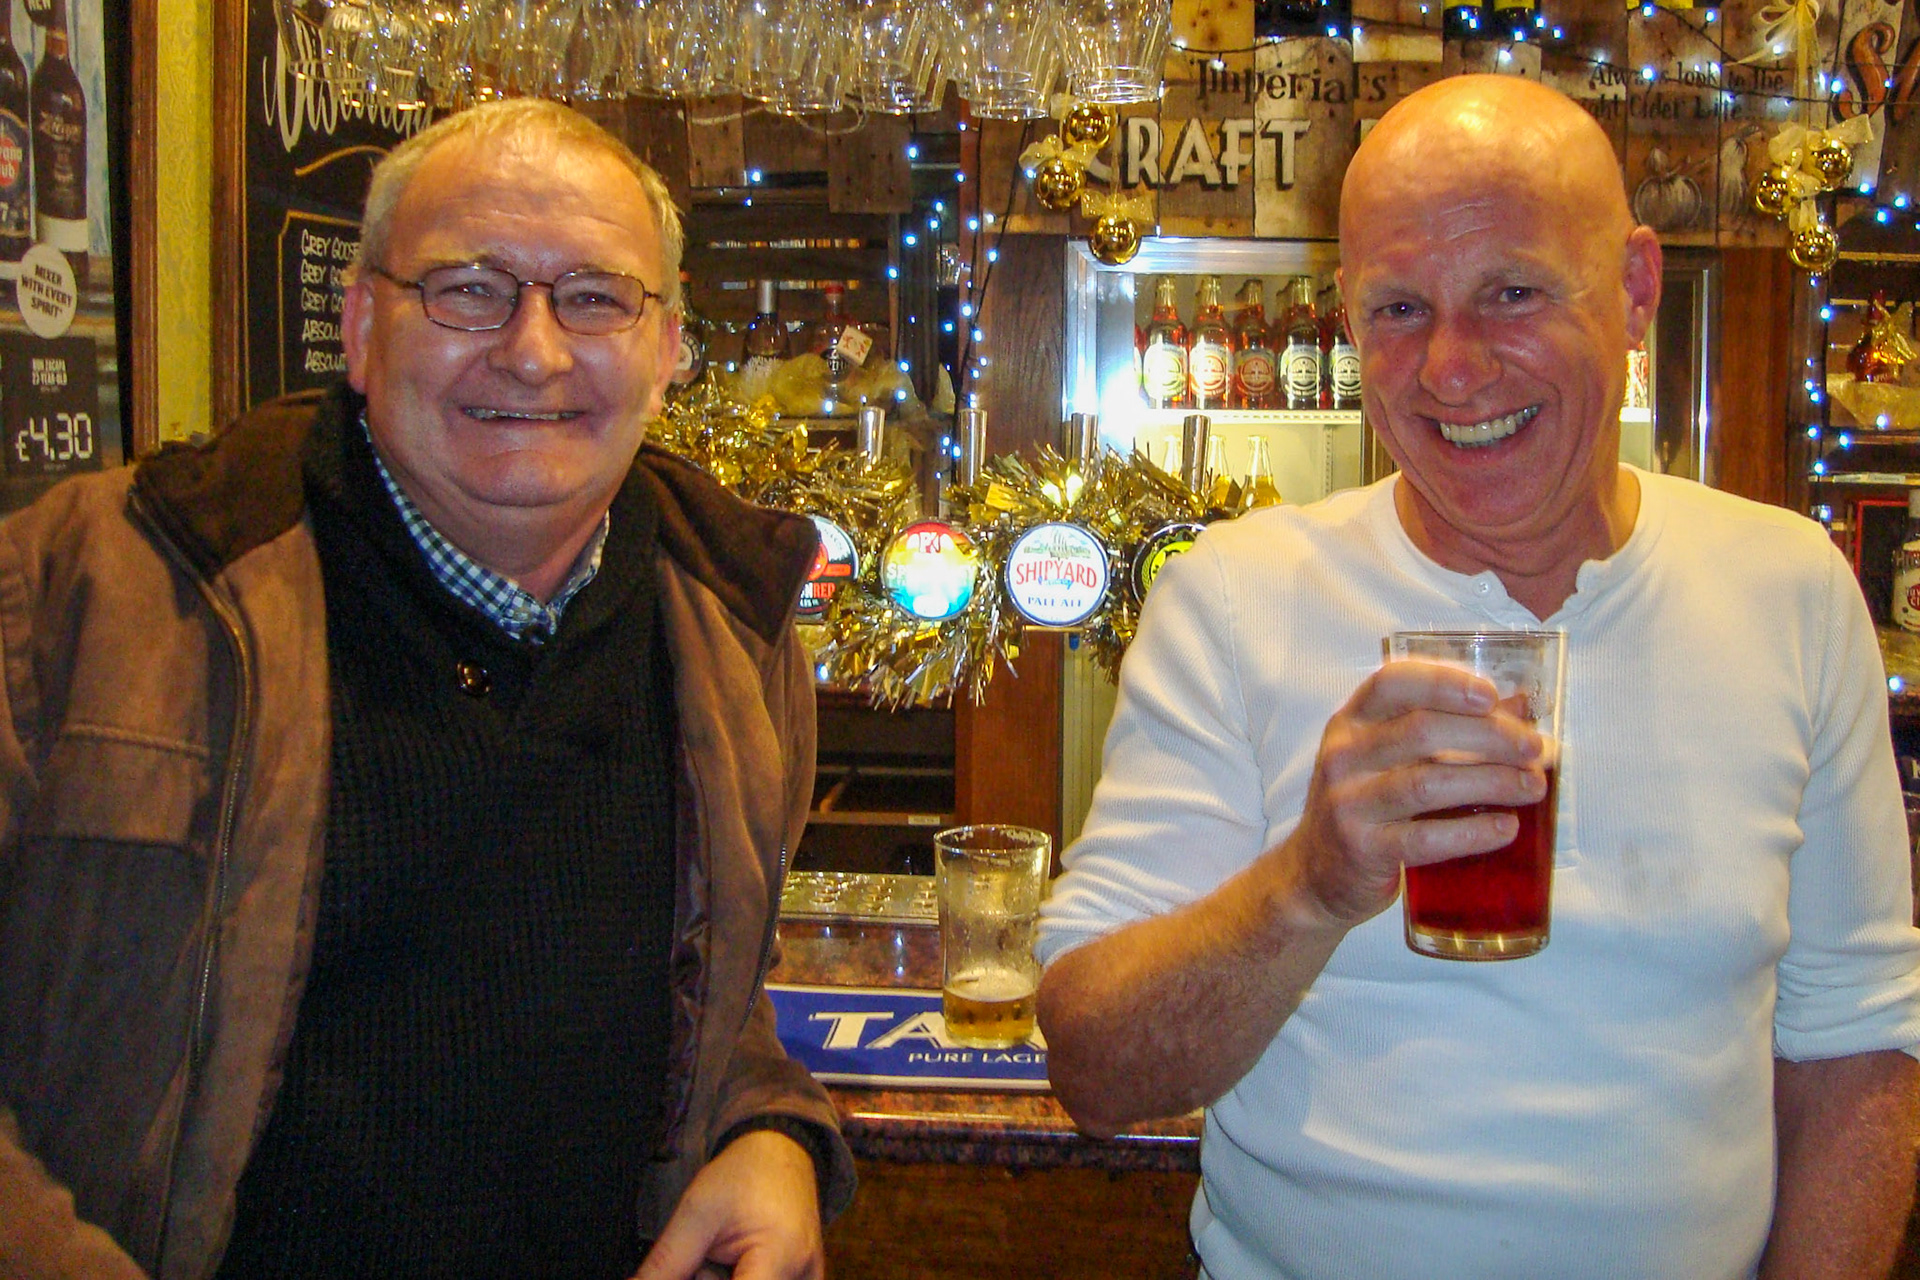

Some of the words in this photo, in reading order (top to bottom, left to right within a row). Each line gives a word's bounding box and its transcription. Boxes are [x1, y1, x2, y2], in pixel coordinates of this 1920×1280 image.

[301, 228, 331, 257] GREY
[35, 264, 62, 286] MIXER
[300, 258, 326, 283] GREY
[21, 274, 44, 294] WITH
[45, 285, 72, 308] EVERY
[301, 287, 327, 313] GREY
[15, 413, 93, 461] £4.30
[1016, 560, 1097, 588] SHIPYARD
[908, 1052, 974, 1063] PURE
[982, 1052, 1046, 1063] LAGE
